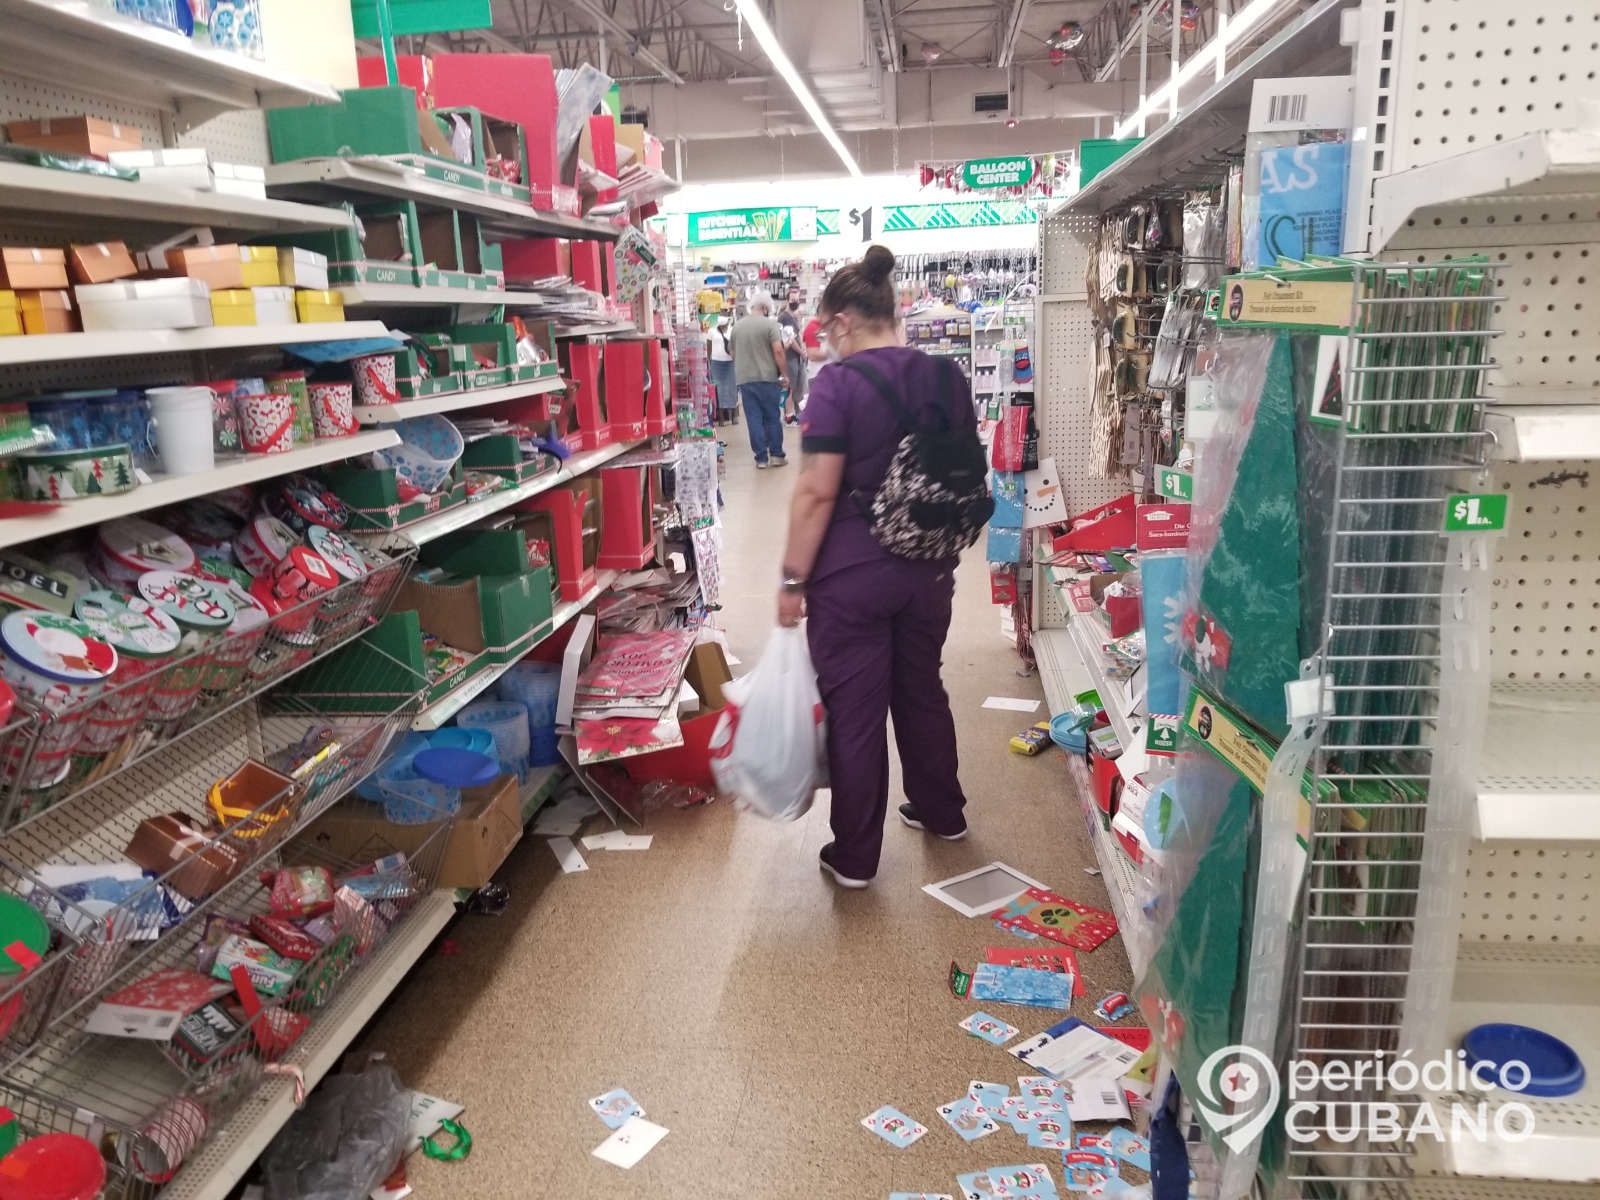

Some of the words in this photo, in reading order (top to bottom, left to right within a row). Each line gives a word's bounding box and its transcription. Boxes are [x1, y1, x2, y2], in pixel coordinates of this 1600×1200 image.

[443, 169, 461, 184] CANDY
[970, 161, 1026, 175] BALLOON
[976, 172, 1020, 185] CENTER
[698, 214, 746, 229] KITCHEN
[849, 205, 872, 243] $1
[698, 224, 767, 241] ESSENTIALS
[376, 269, 396, 281] CANDY
[1165, 474, 1180, 497] $1
[1454, 498, 1480, 525] $1
[0, 561, 63, 597] OEL
[449, 668, 467, 689] CANDY
